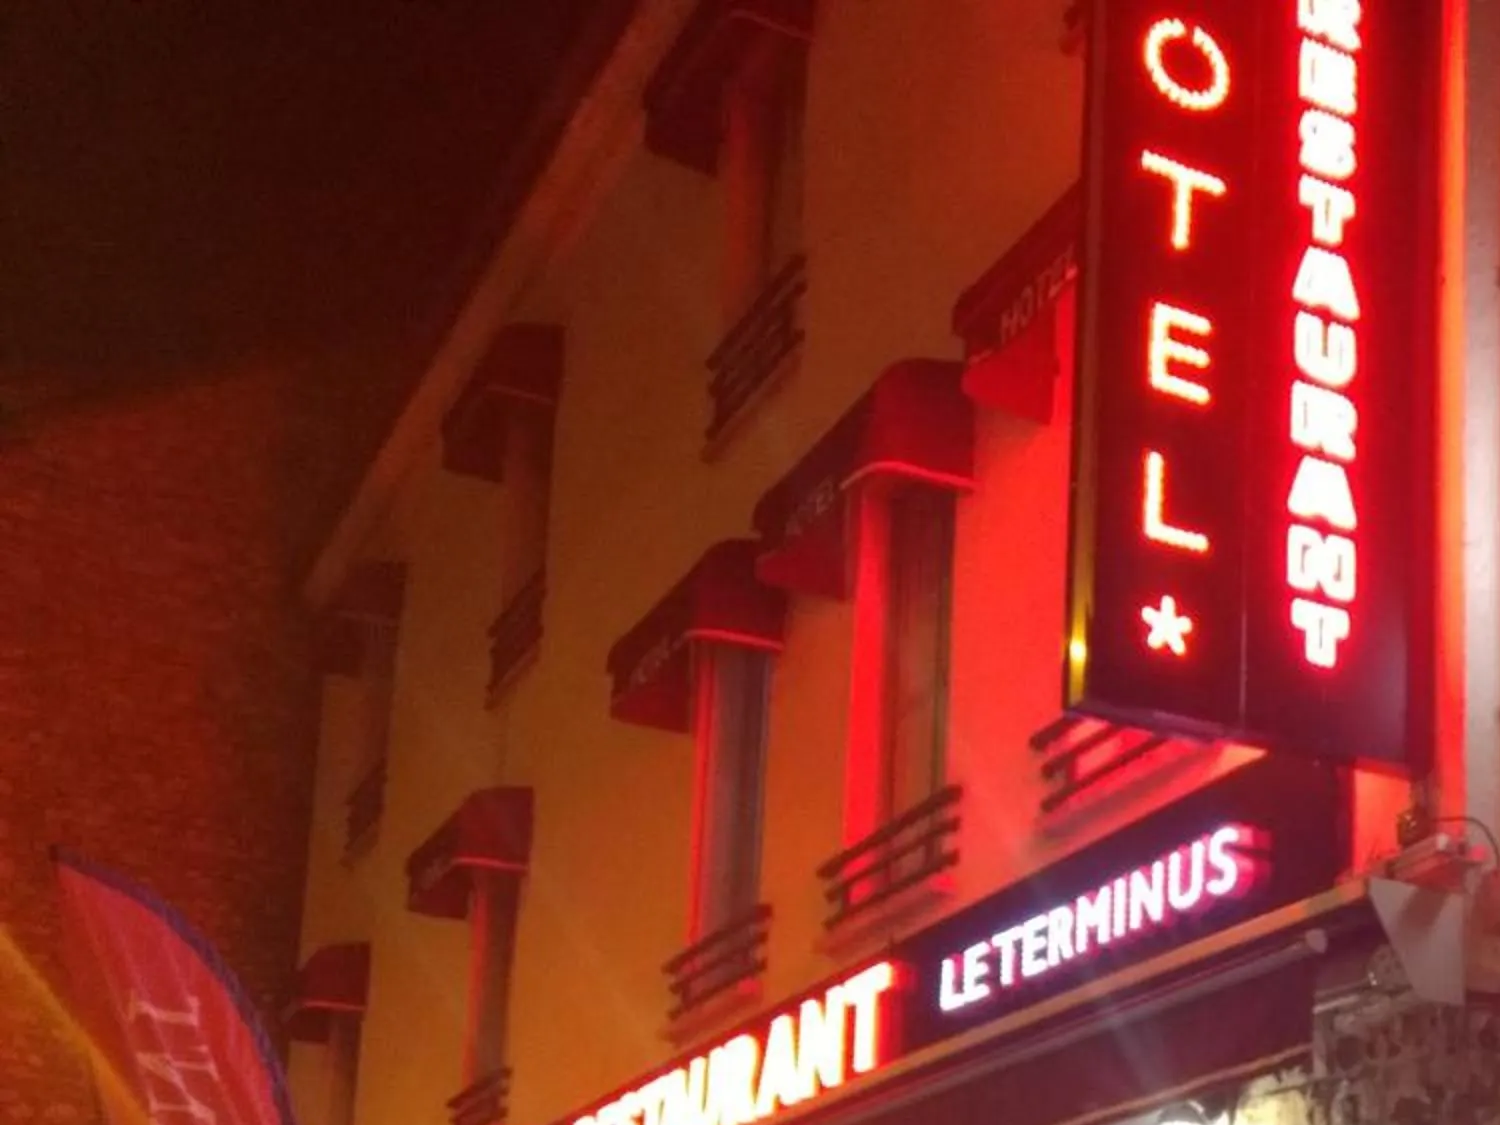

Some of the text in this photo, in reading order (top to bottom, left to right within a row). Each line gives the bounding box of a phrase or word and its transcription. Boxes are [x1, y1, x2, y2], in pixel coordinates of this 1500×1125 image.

[1140, 16, 1230, 554] OTEL
[1287, 0, 1362, 669] RESTAURANT
[938, 825, 1245, 1013] LE TERMINUS
